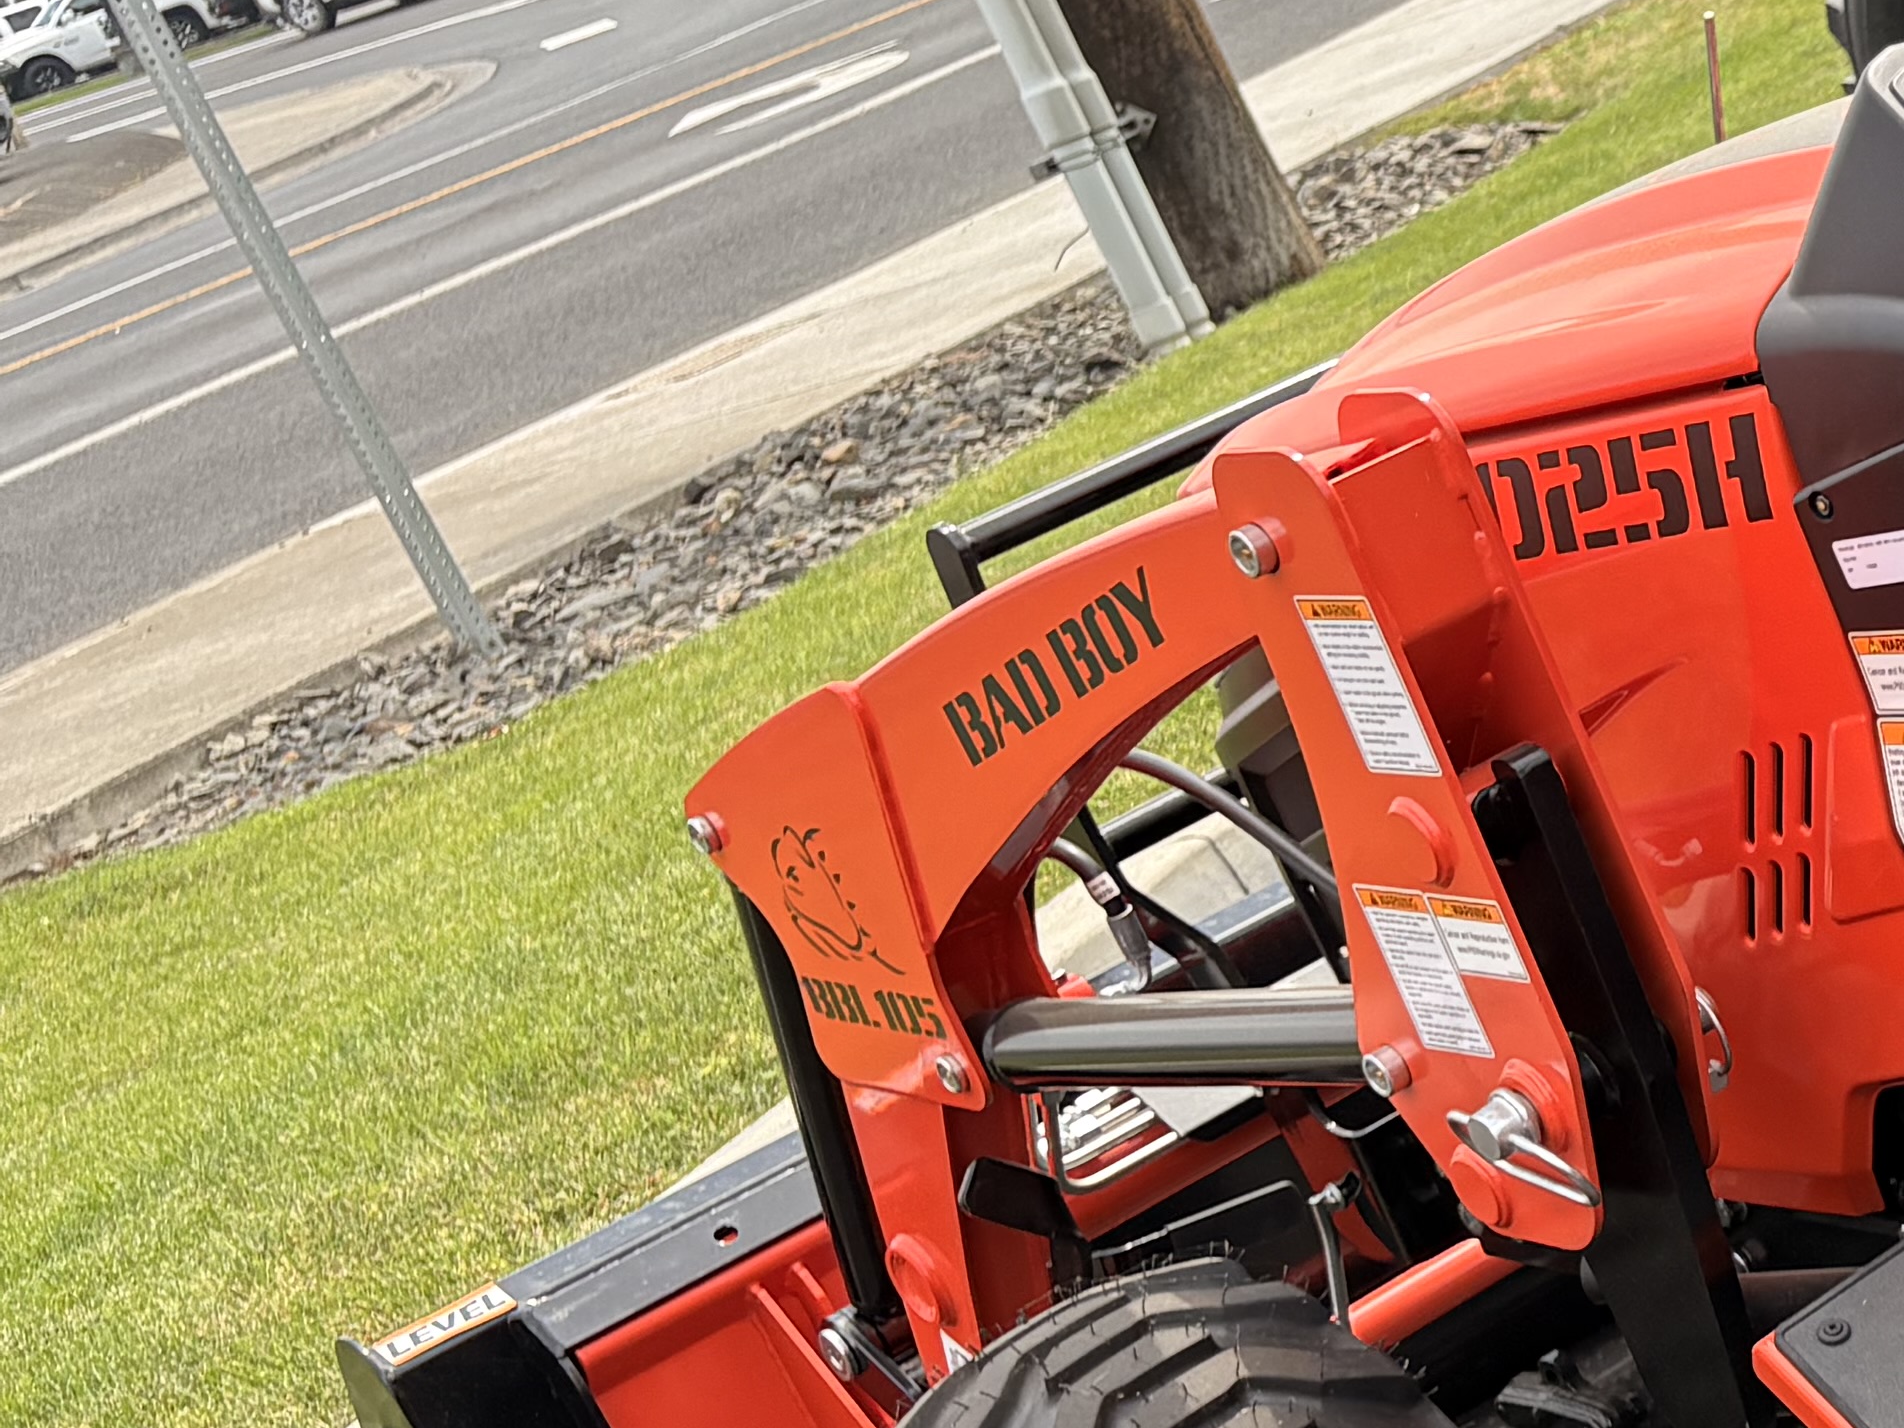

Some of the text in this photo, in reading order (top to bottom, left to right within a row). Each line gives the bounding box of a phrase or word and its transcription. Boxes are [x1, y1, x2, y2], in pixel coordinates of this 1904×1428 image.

[942, 648, 1061, 768] BAD
[1047, 566, 1168, 701] BOY
[386, 1291, 507, 1360] LEVEL
